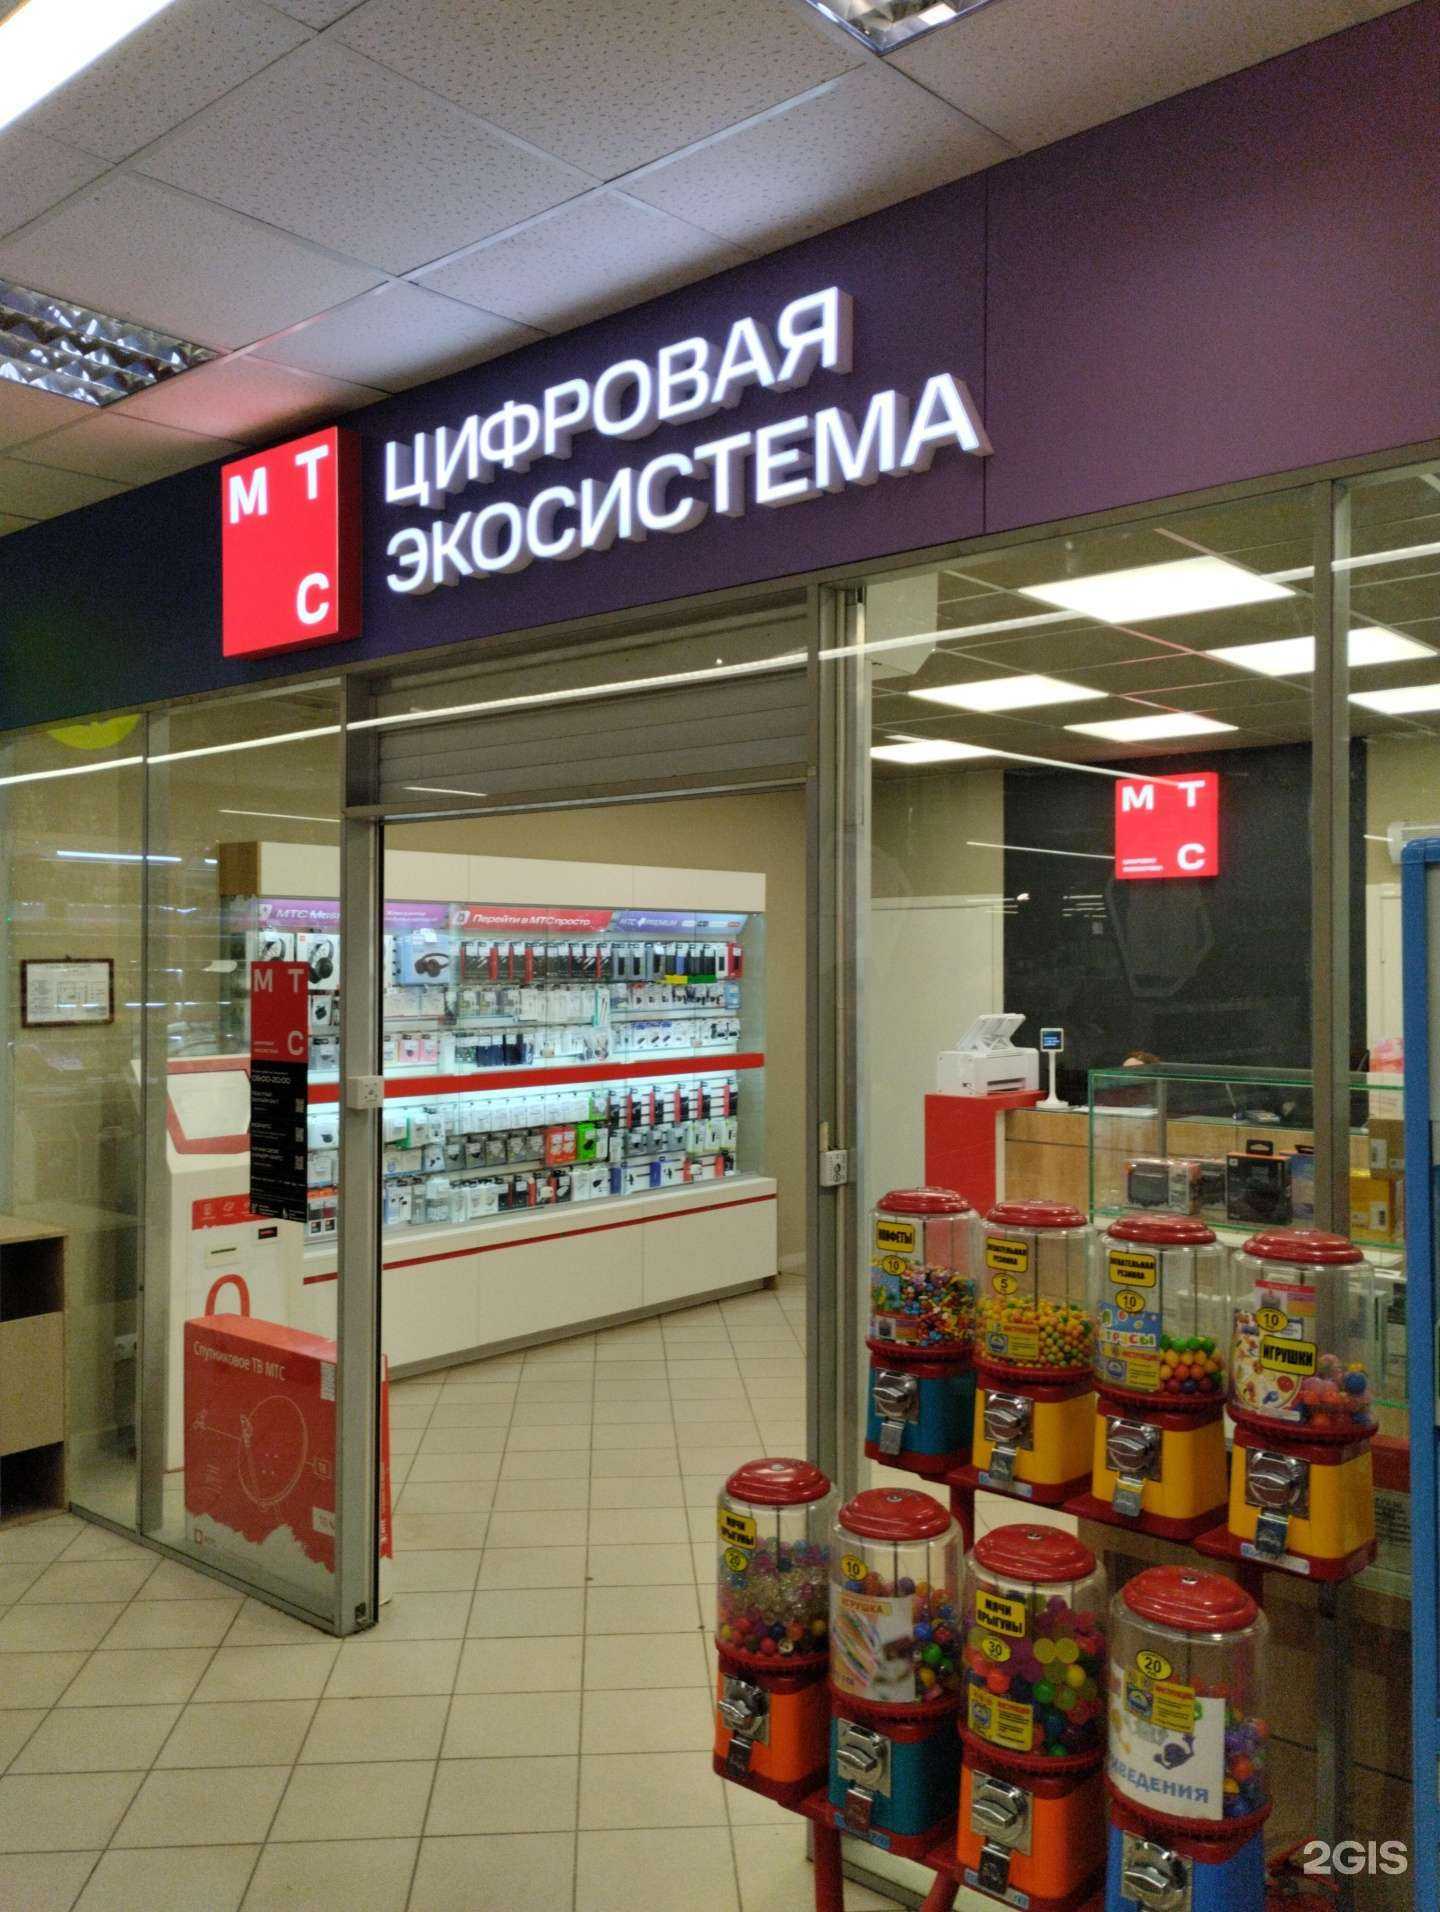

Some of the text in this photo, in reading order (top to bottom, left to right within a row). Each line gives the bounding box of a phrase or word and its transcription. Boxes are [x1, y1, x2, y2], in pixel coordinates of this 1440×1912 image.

[384, 285, 841, 506] ЦИФРОВАЯ
[386, 372, 980, 594] ЭКОСИСТЕМА
[1123, 1295, 1137, 1307] 10
[1264, 1313, 1280, 1326] 10
[1263, 1343, 1313, 1367] ИГРУШКИ
[846, 1560, 860, 1575] 10
[1144, 1656, 1163, 1674] 20
